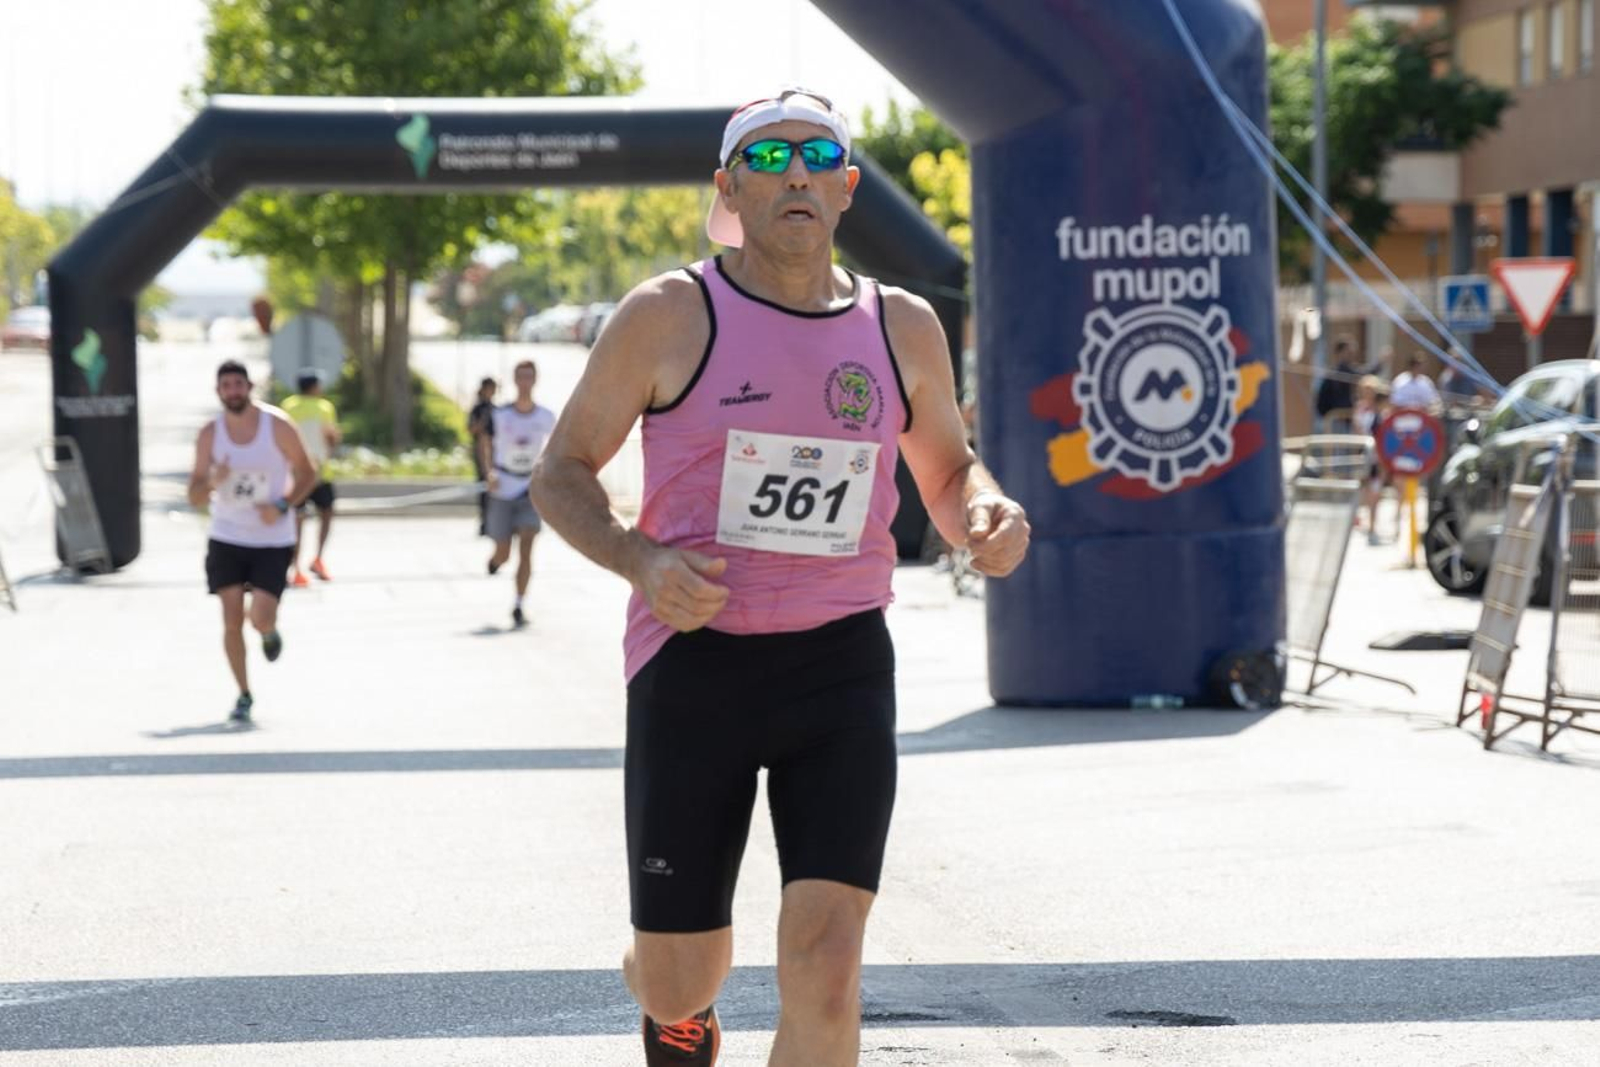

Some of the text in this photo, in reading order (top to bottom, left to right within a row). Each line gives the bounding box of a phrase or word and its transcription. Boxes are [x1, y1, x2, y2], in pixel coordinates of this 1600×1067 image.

[1056, 213, 1250, 260] fundación
[1093, 257, 1220, 305] mupol
[749, 473, 850, 524] 561
